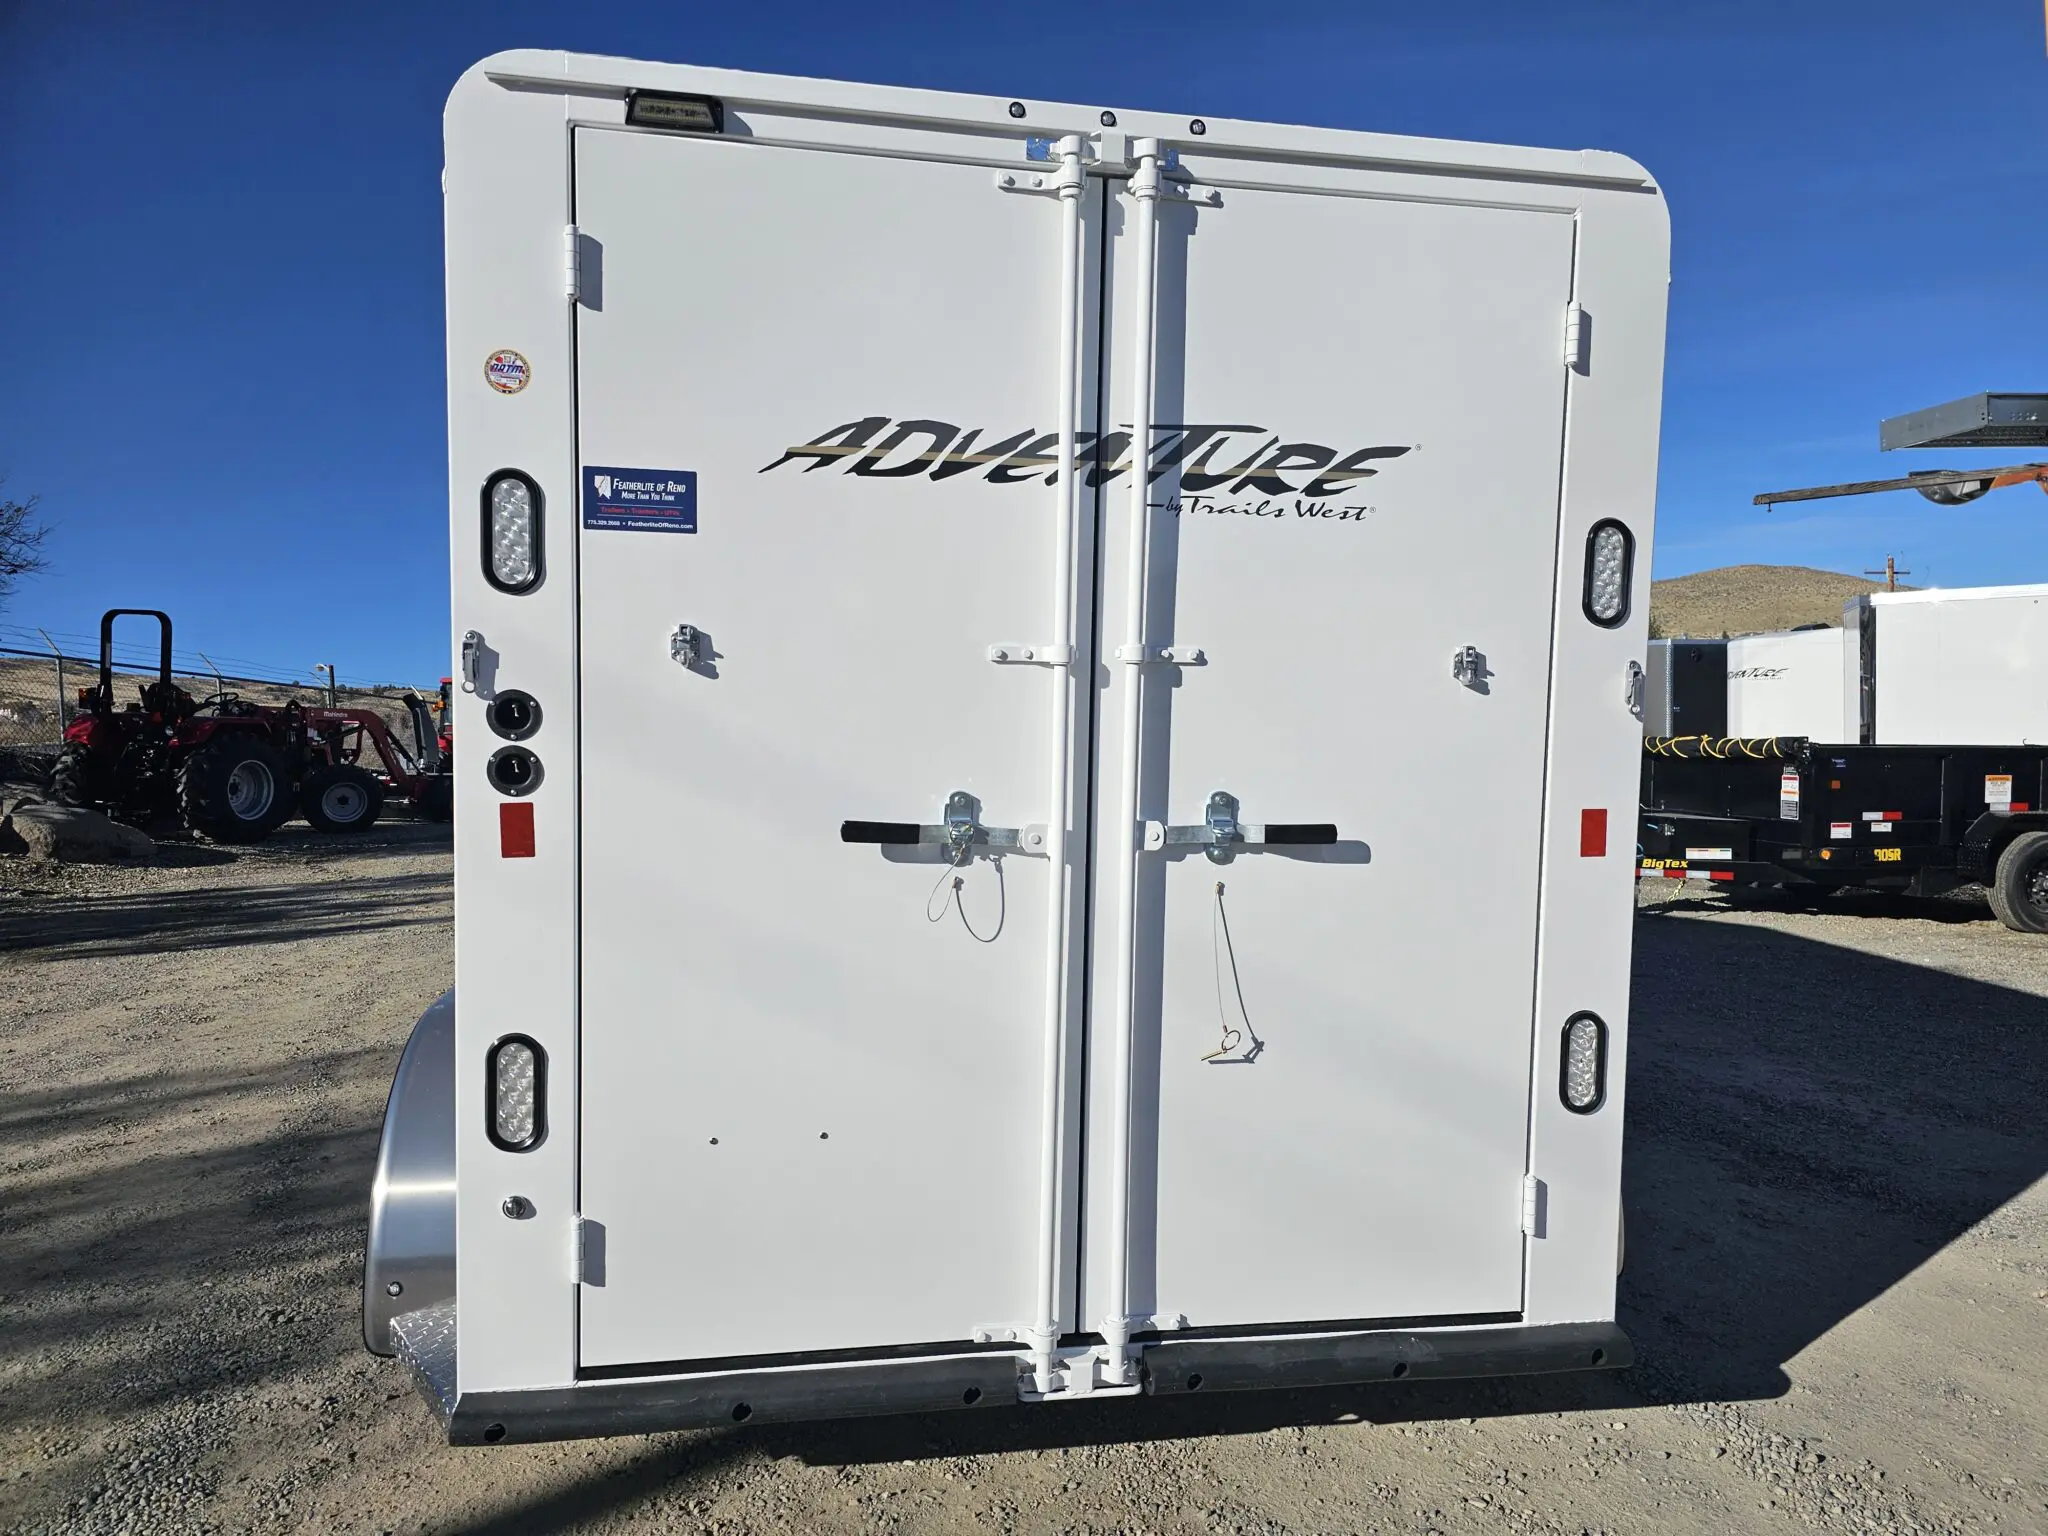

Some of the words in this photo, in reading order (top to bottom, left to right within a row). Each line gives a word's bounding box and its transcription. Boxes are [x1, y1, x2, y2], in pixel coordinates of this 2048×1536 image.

[758, 416, 1412, 498] ADVENTURE
[1180, 496, 1286, 518] Trails
[1294, 499, 1368, 521] West
[628, 520, 694, 530] FeatherliteOfReno.com
